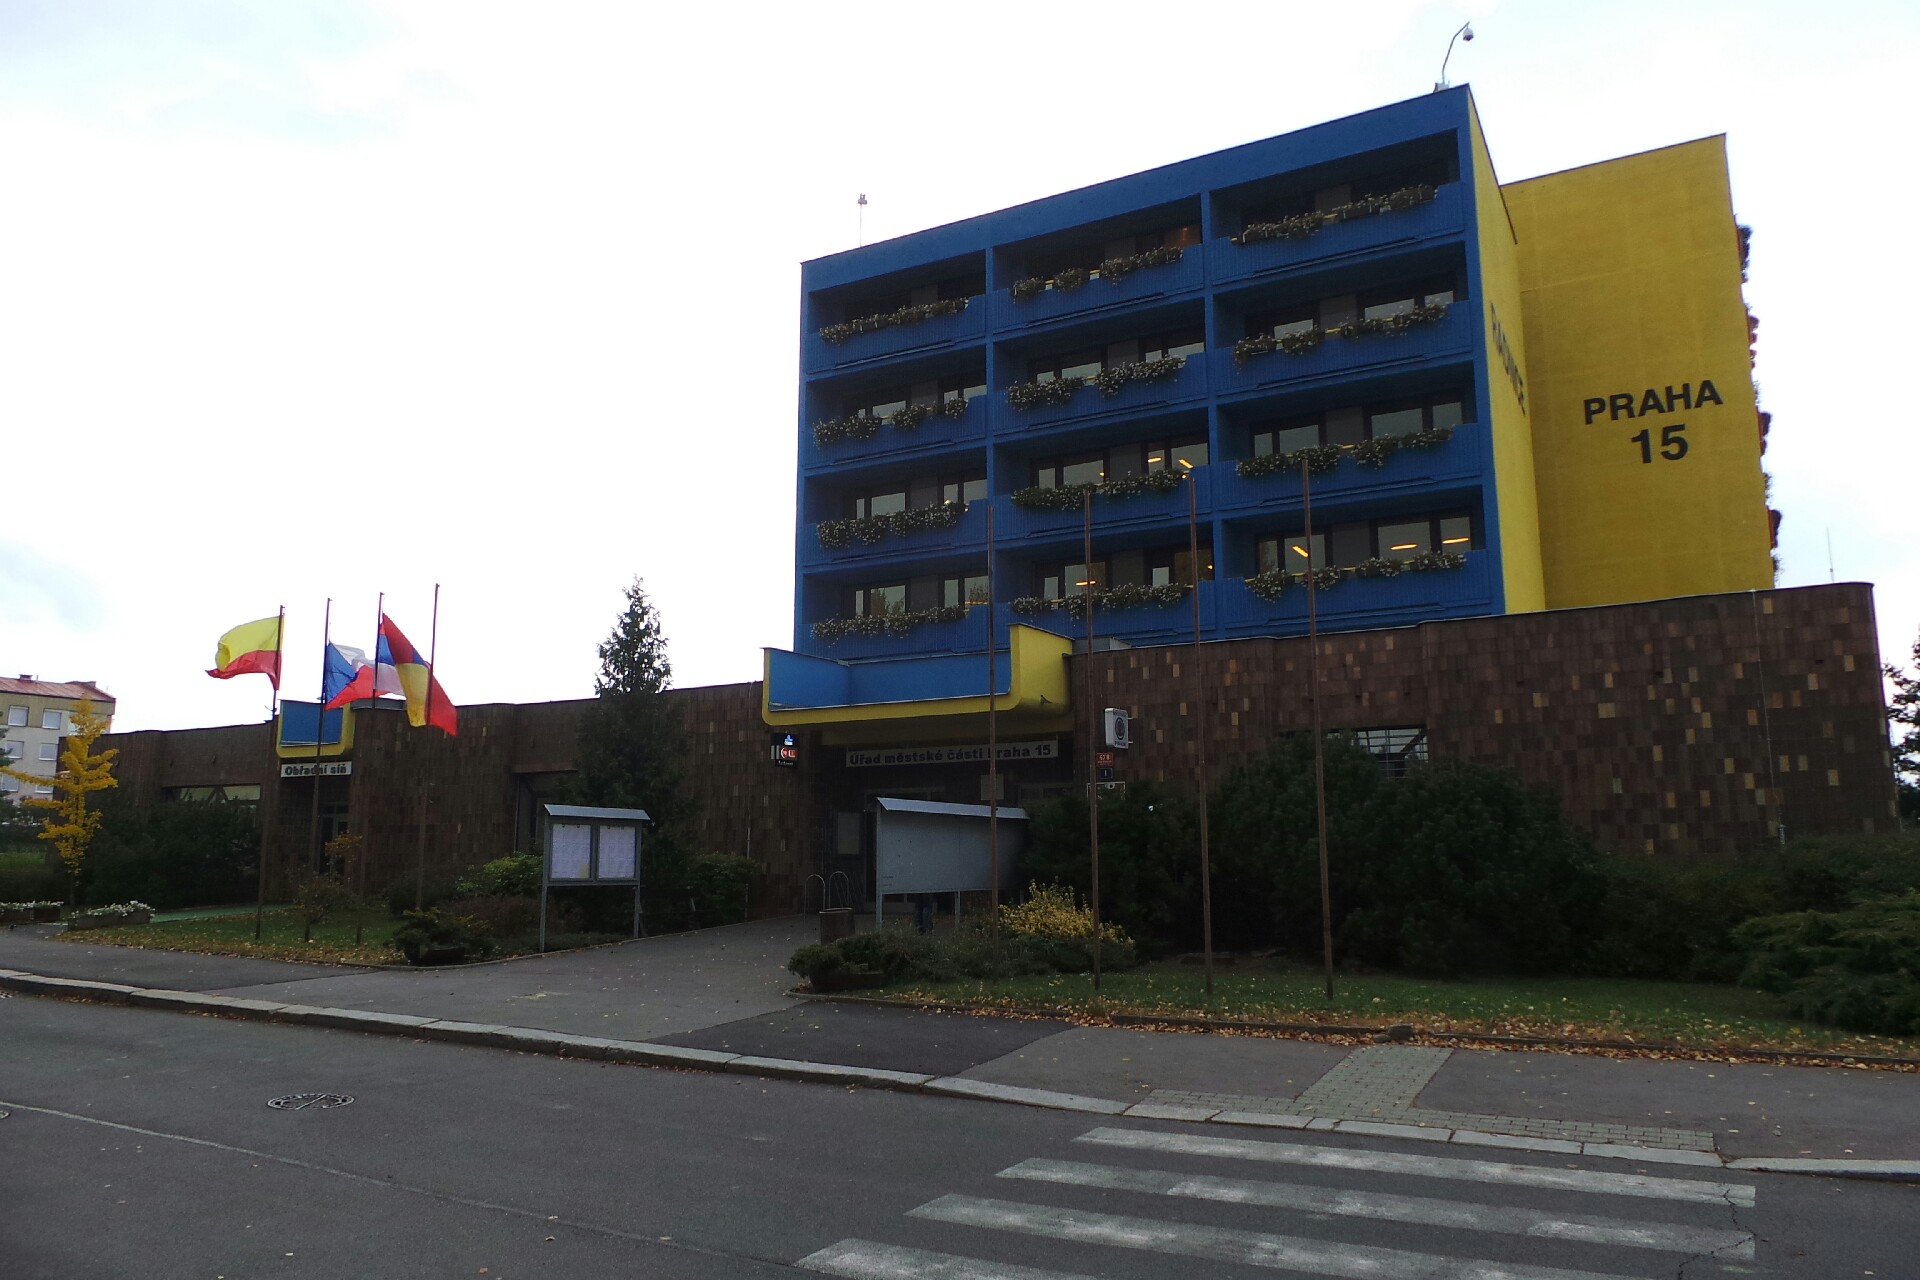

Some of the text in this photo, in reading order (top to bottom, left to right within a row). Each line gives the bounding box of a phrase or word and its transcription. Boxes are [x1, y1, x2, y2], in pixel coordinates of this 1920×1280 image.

[1583, 379, 1724, 425] PRAHA
[1630, 424, 1690, 464] 15
[330, 763, 347, 775] síň
[849, 752, 881, 765] Úřad
[884, 749, 943, 764] městské
[946, 747, 983, 761] části
[1034, 744, 1051, 756] 15
